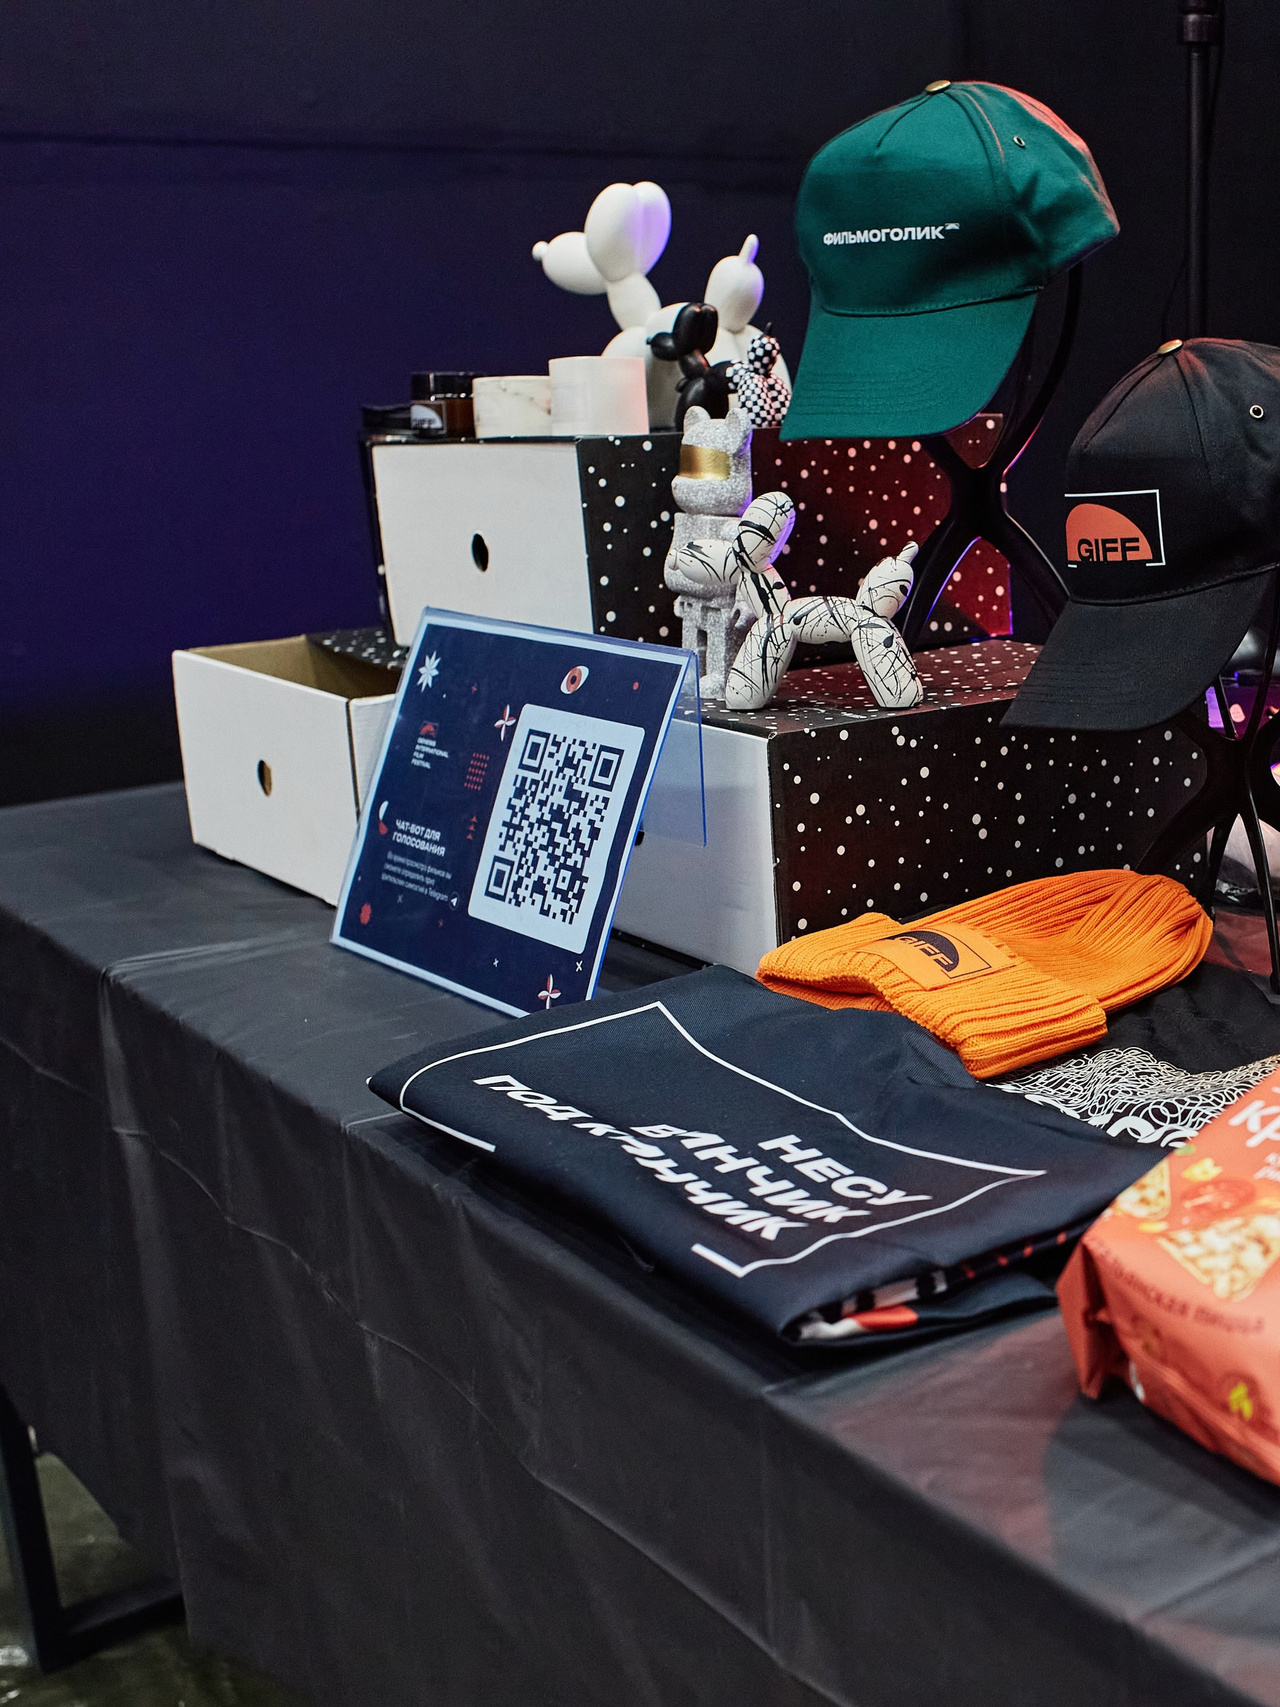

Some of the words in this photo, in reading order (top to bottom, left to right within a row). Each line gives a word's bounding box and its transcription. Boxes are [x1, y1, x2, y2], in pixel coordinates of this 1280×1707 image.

[823, 225, 945, 245] ФИЛЬМОГОЛИК
[1077, 537, 1140, 562] GIFF
[395, 819, 425, 837] ЧАТ-БОТ
[423, 828, 441, 842] ДЛЯ
[392, 831, 446, 857] ГОЛОСОВАНИЯ
[473, 1075, 593, 1121] ПОД
[757, 1134, 933, 1206] НЕСУ
